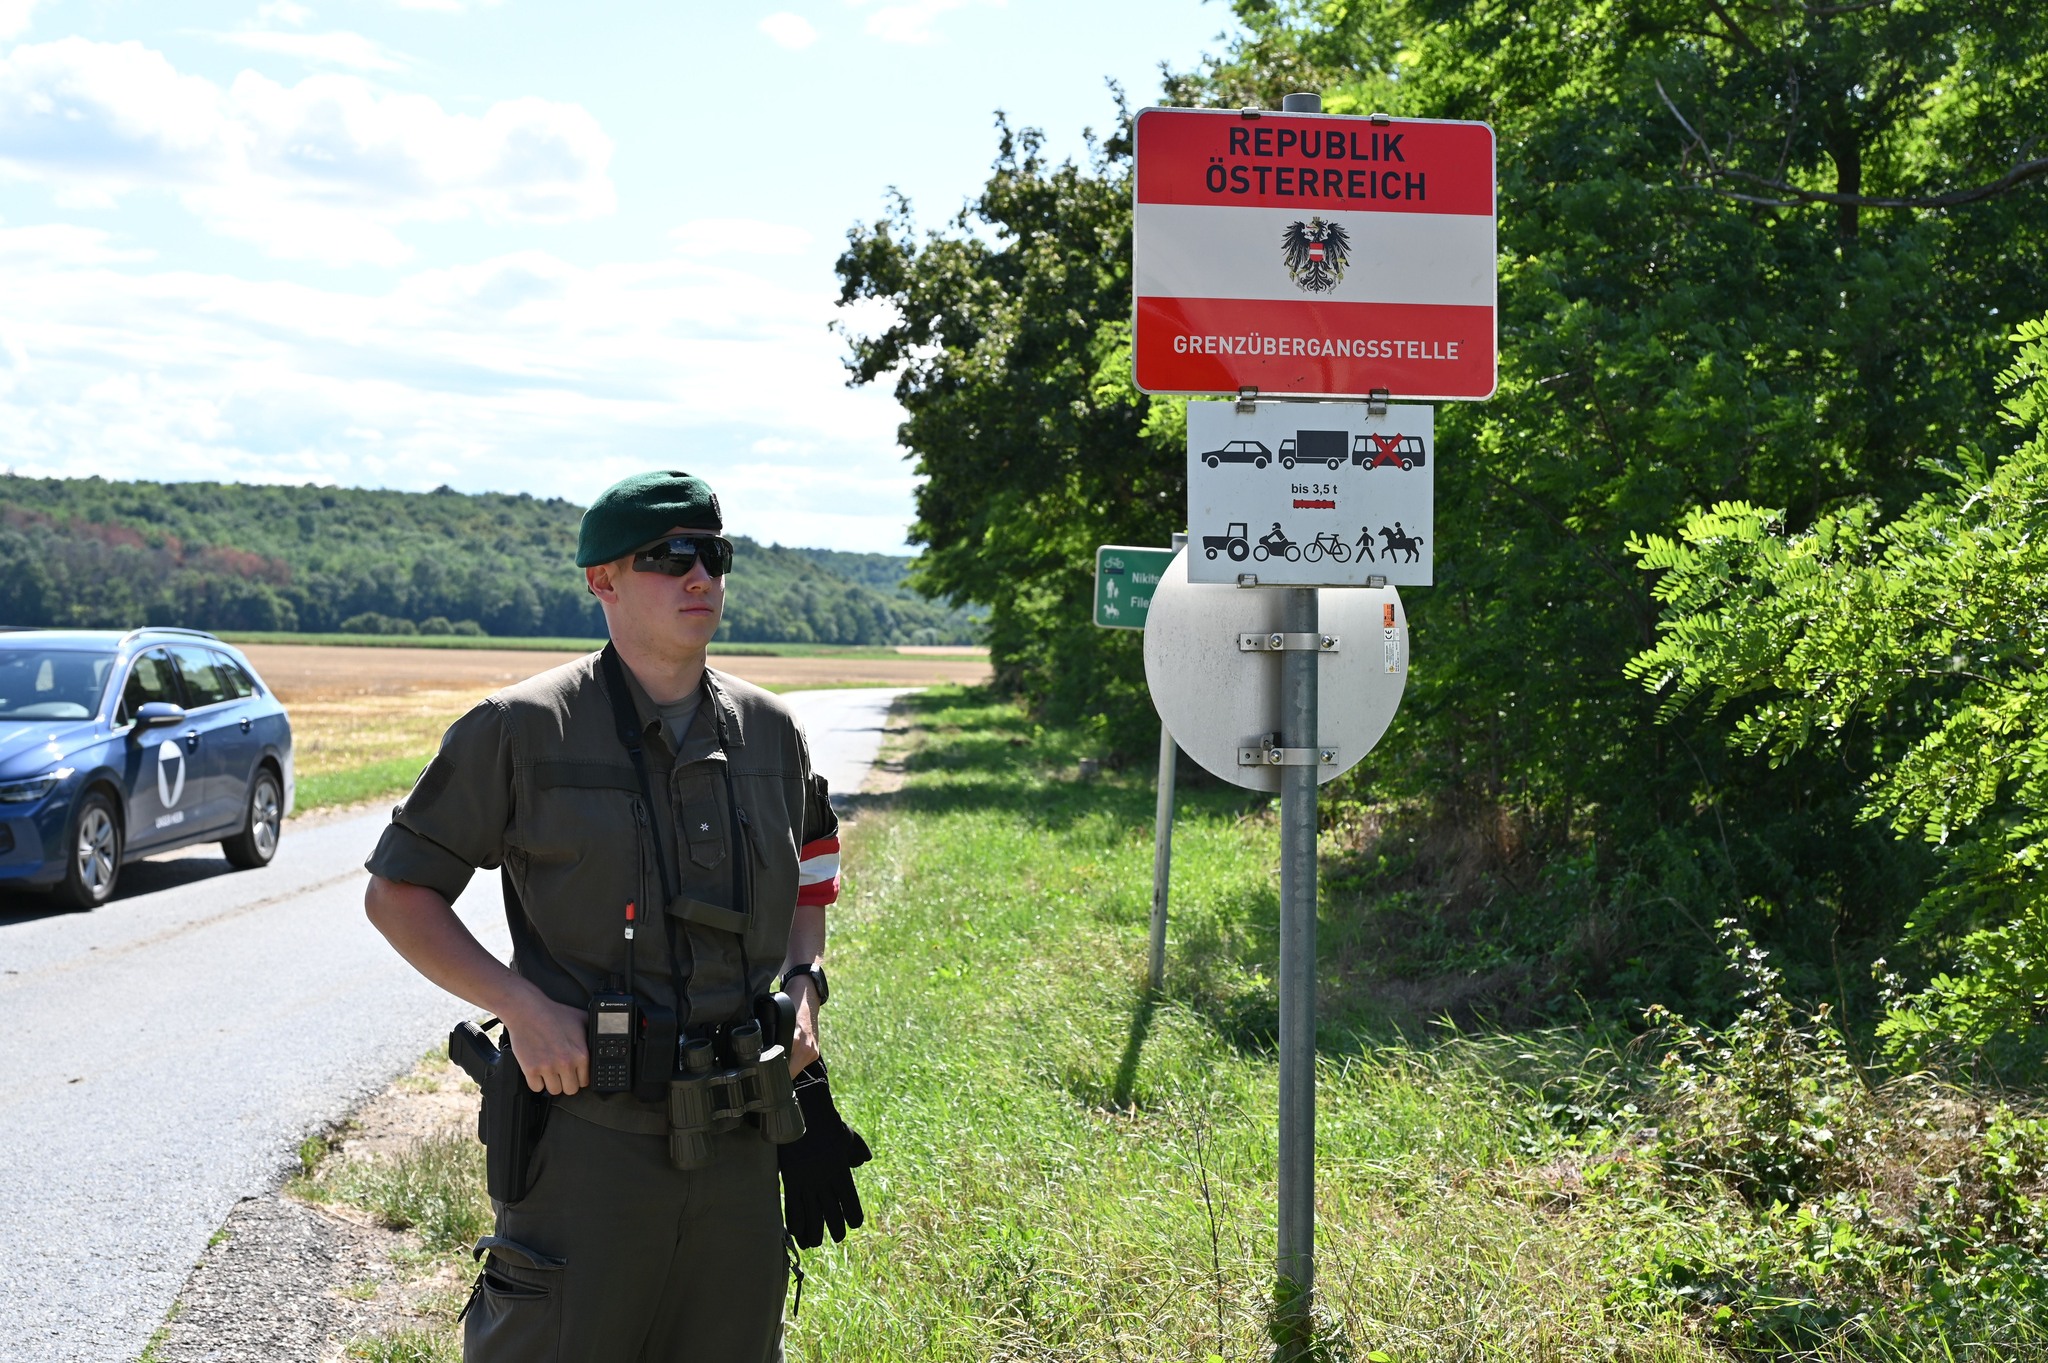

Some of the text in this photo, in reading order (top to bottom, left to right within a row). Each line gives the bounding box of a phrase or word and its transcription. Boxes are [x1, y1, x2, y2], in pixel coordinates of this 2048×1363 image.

[1229, 127, 1405, 162] REPUBLIK
[1206, 157, 1426, 200] ÖSTERREICH
[1173, 333, 1459, 361] GRENZÜBERGANGSSTELLE
[1291, 483, 1338, 496] bis 3,5 t
